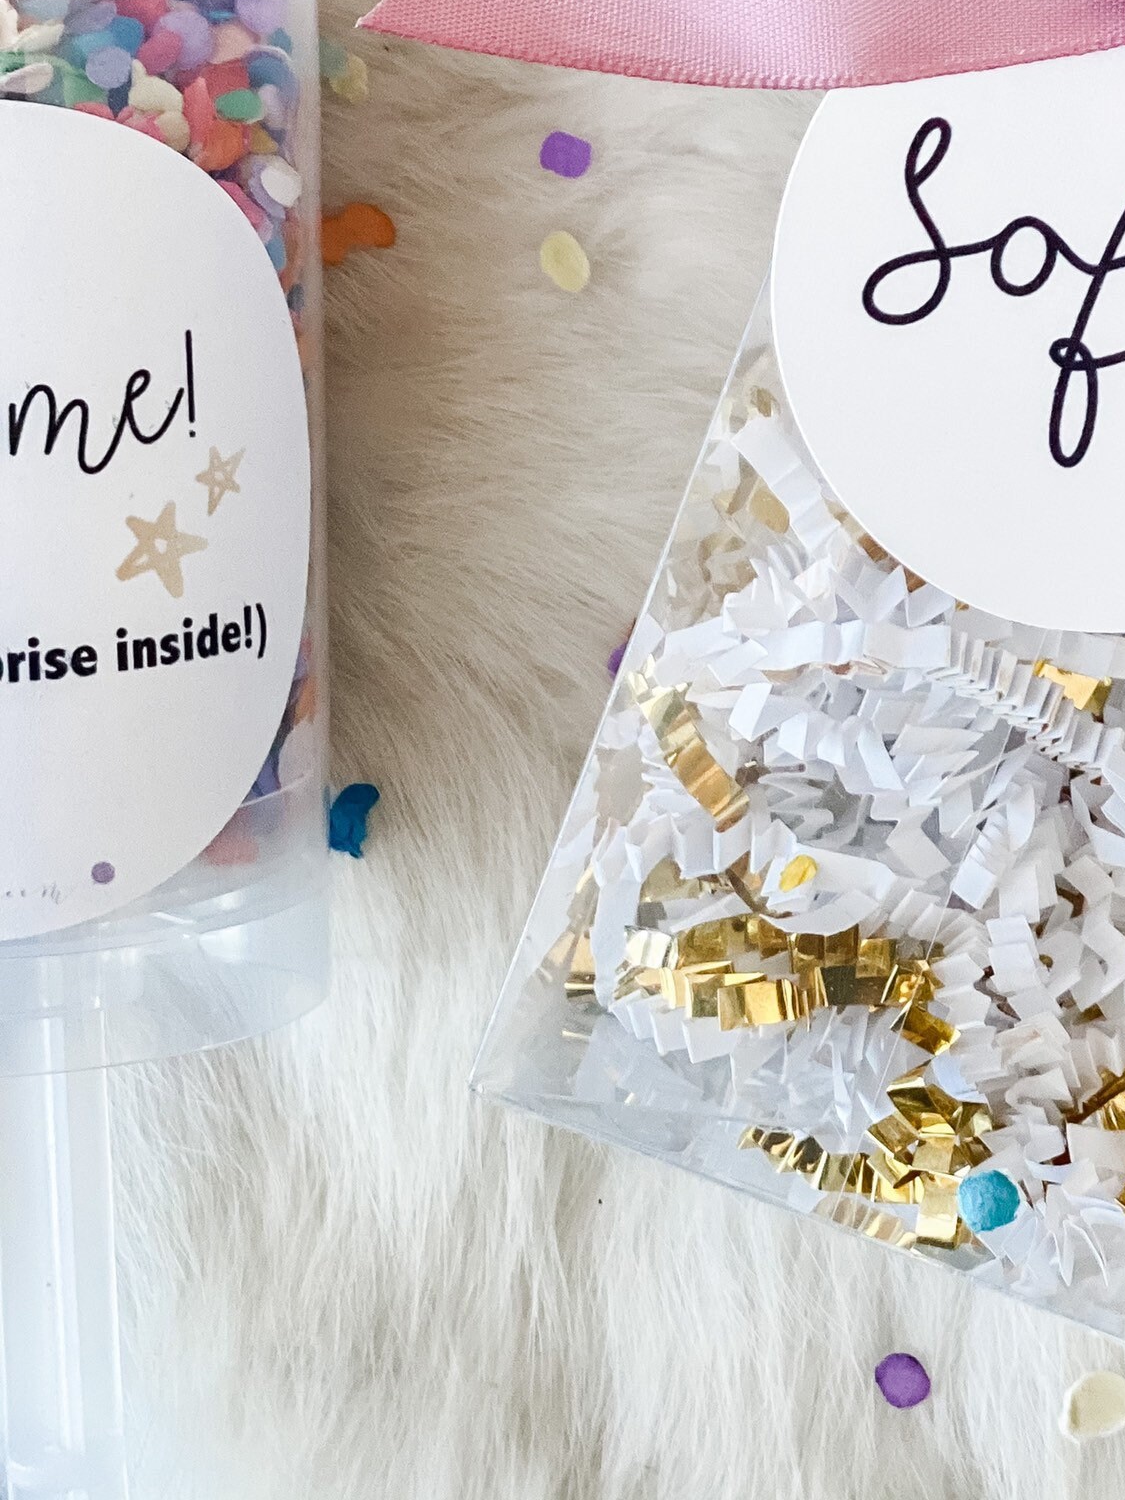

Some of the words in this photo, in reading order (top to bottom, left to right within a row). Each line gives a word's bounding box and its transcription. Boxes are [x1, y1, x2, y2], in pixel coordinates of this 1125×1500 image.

[8, 329, 197, 475] me!
[0, 636, 98, 684] rise
[115, 602, 267, 672] inside!)
